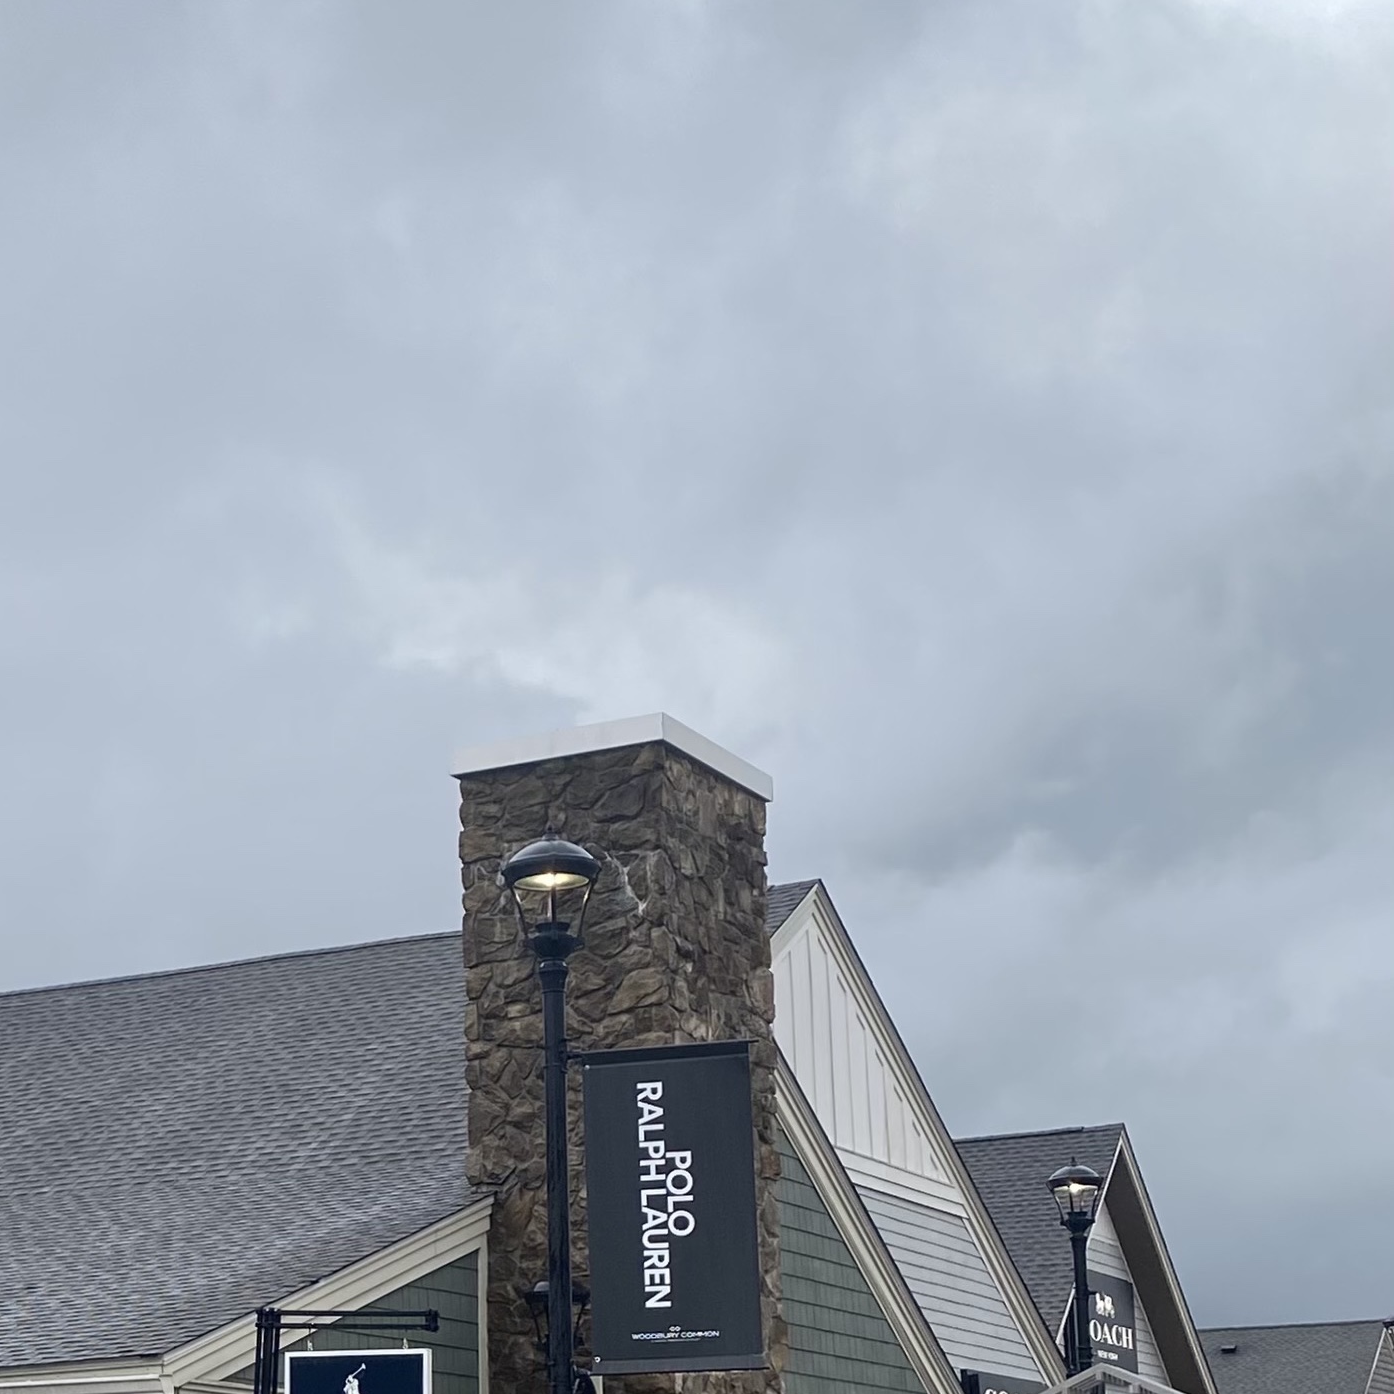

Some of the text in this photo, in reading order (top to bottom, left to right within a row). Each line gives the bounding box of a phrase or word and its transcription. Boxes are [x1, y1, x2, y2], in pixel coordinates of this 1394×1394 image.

[636, 1081, 672, 1309] RALPH LAUREN
[665, 1150, 696, 1237] POLO
[1089, 1319, 1134, 1350] OACH
